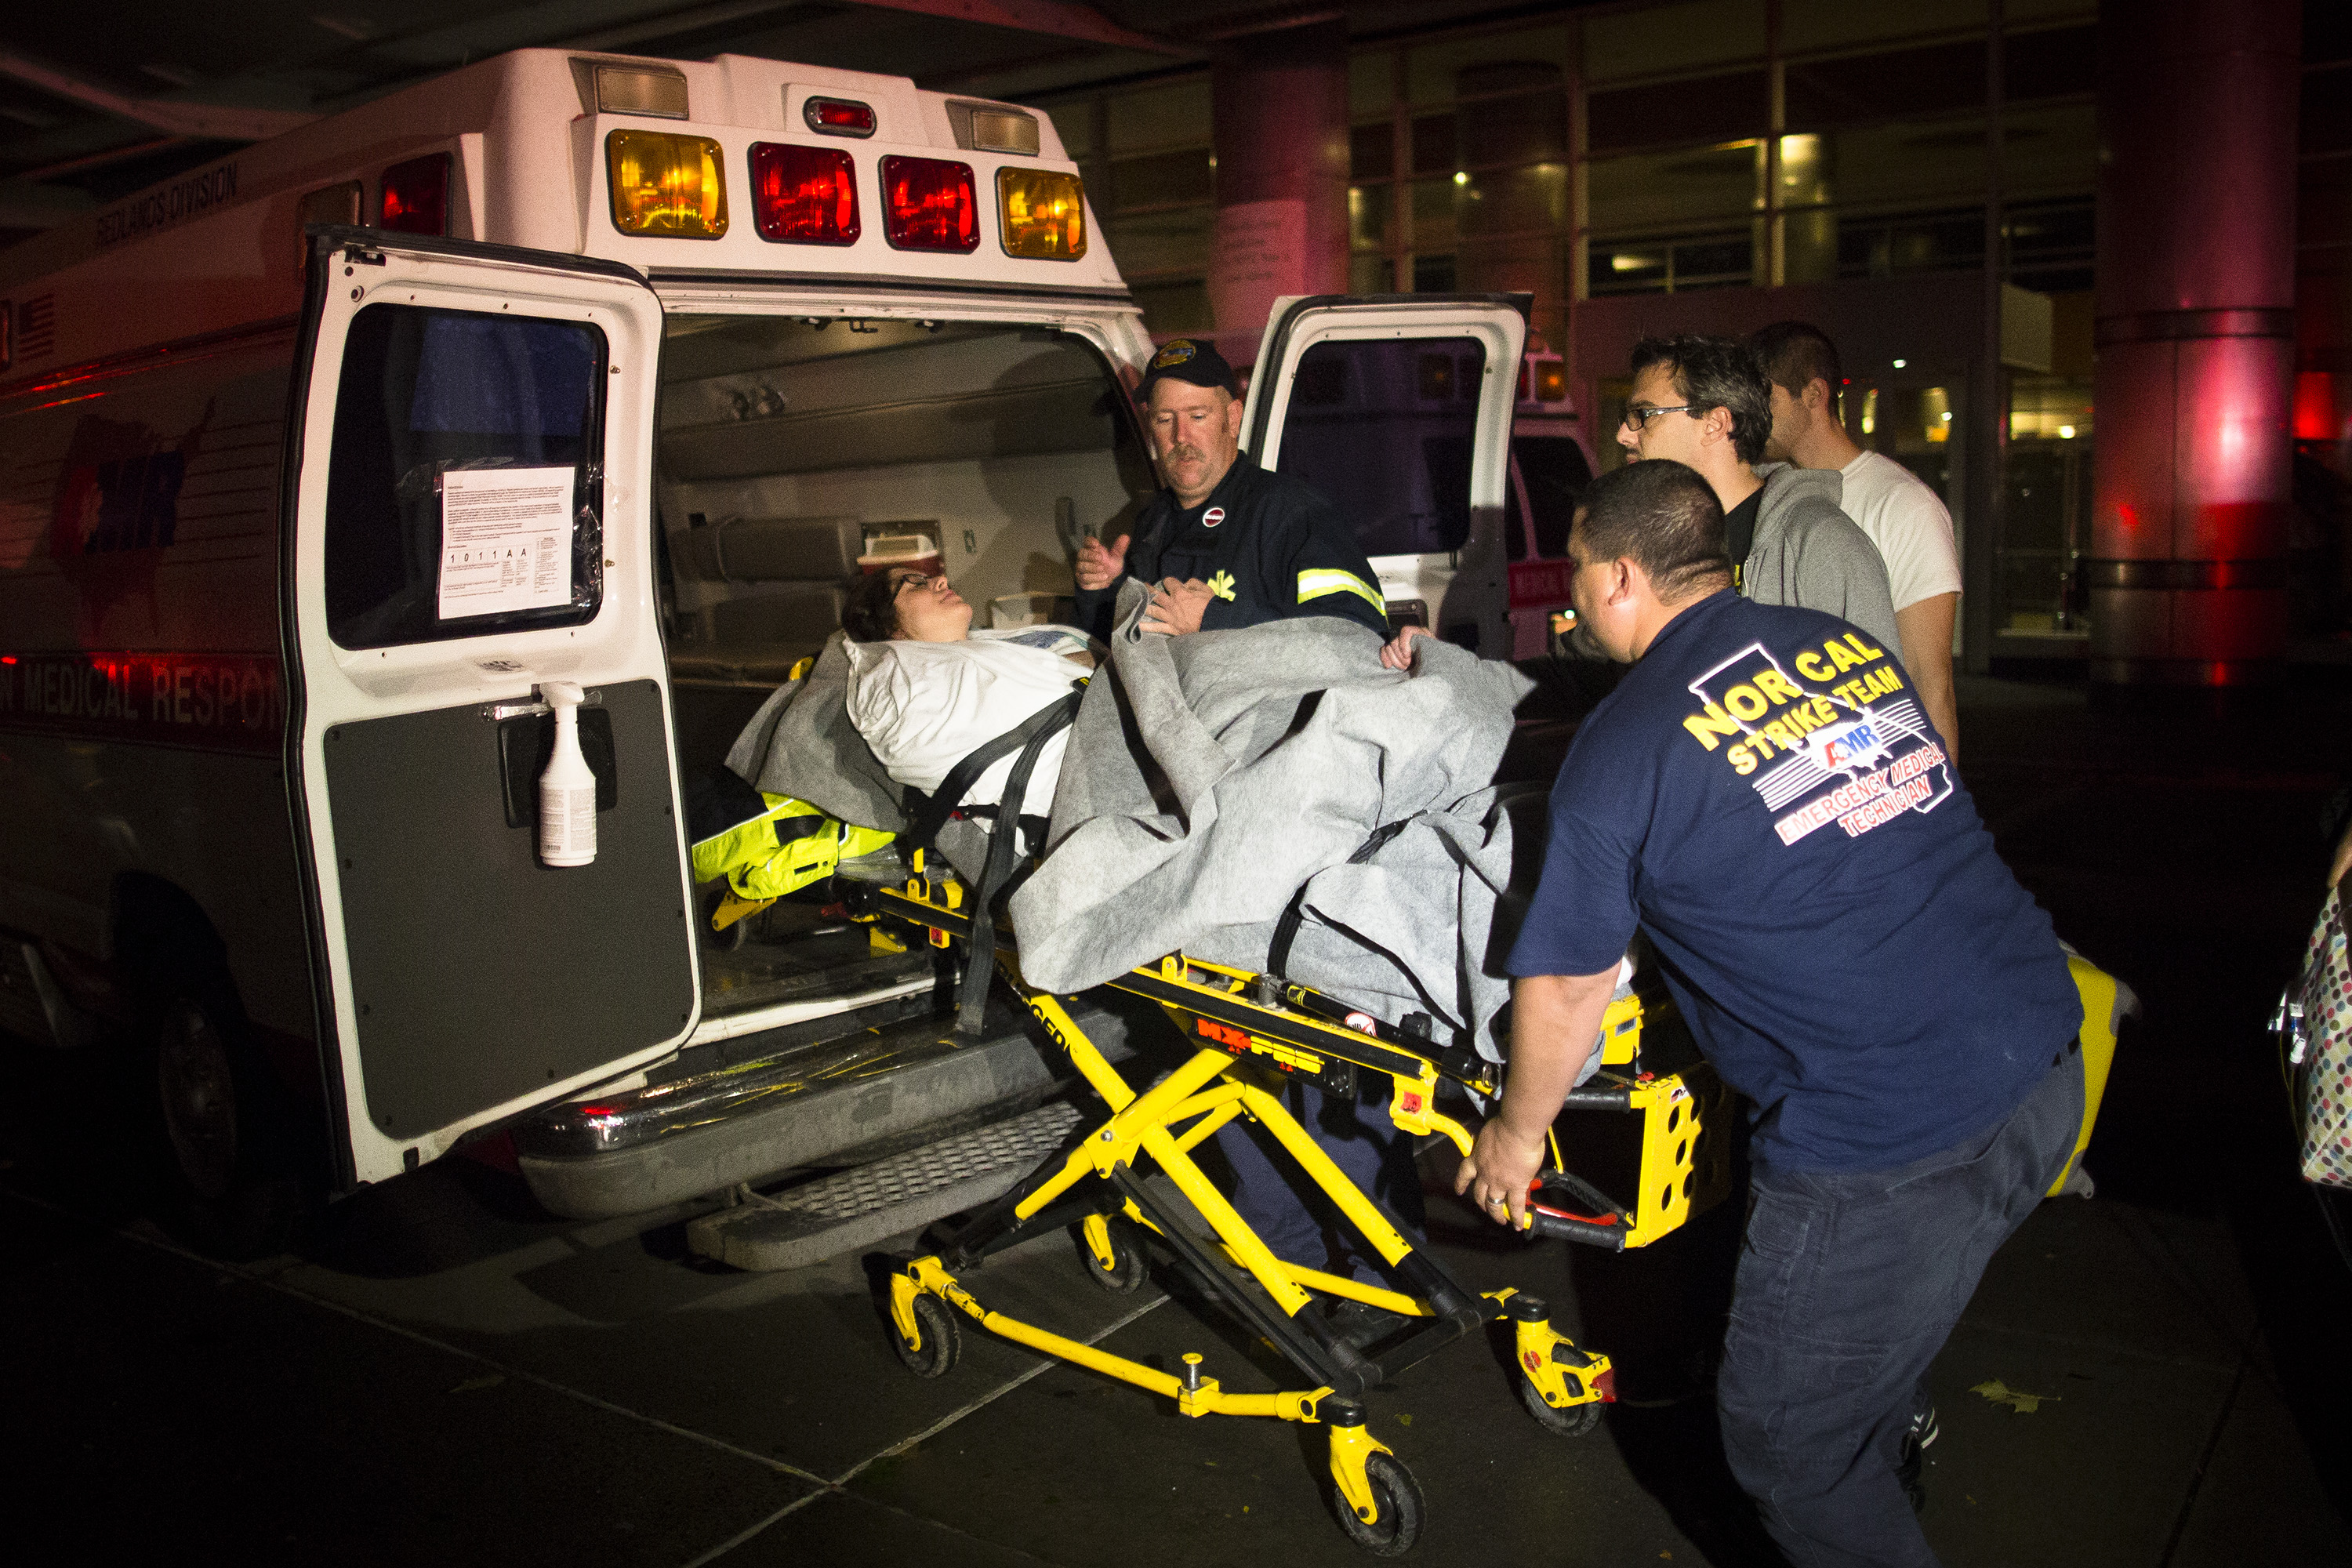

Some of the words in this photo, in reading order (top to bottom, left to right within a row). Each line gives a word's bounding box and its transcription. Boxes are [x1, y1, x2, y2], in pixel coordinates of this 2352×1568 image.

[170, 162, 237, 220] DIVISION
[506, 549, 513, 558] A
[521, 547, 527, 557] A
[25, 662, 139, 720] MEDICAL
[1683, 670, 1803, 751] NOR
[1795, 633, 1883, 681] CAL
[1727, 695, 1838, 775] STRIKE
[1832, 666, 1904, 711] TEAM
[1824, 724, 1880, 768] AMR
[1776, 768, 1889, 844] EMERGENCY
[1889, 742, 1945, 786] MEDICAL
[1838, 774, 1933, 837] TECHNICIAN
